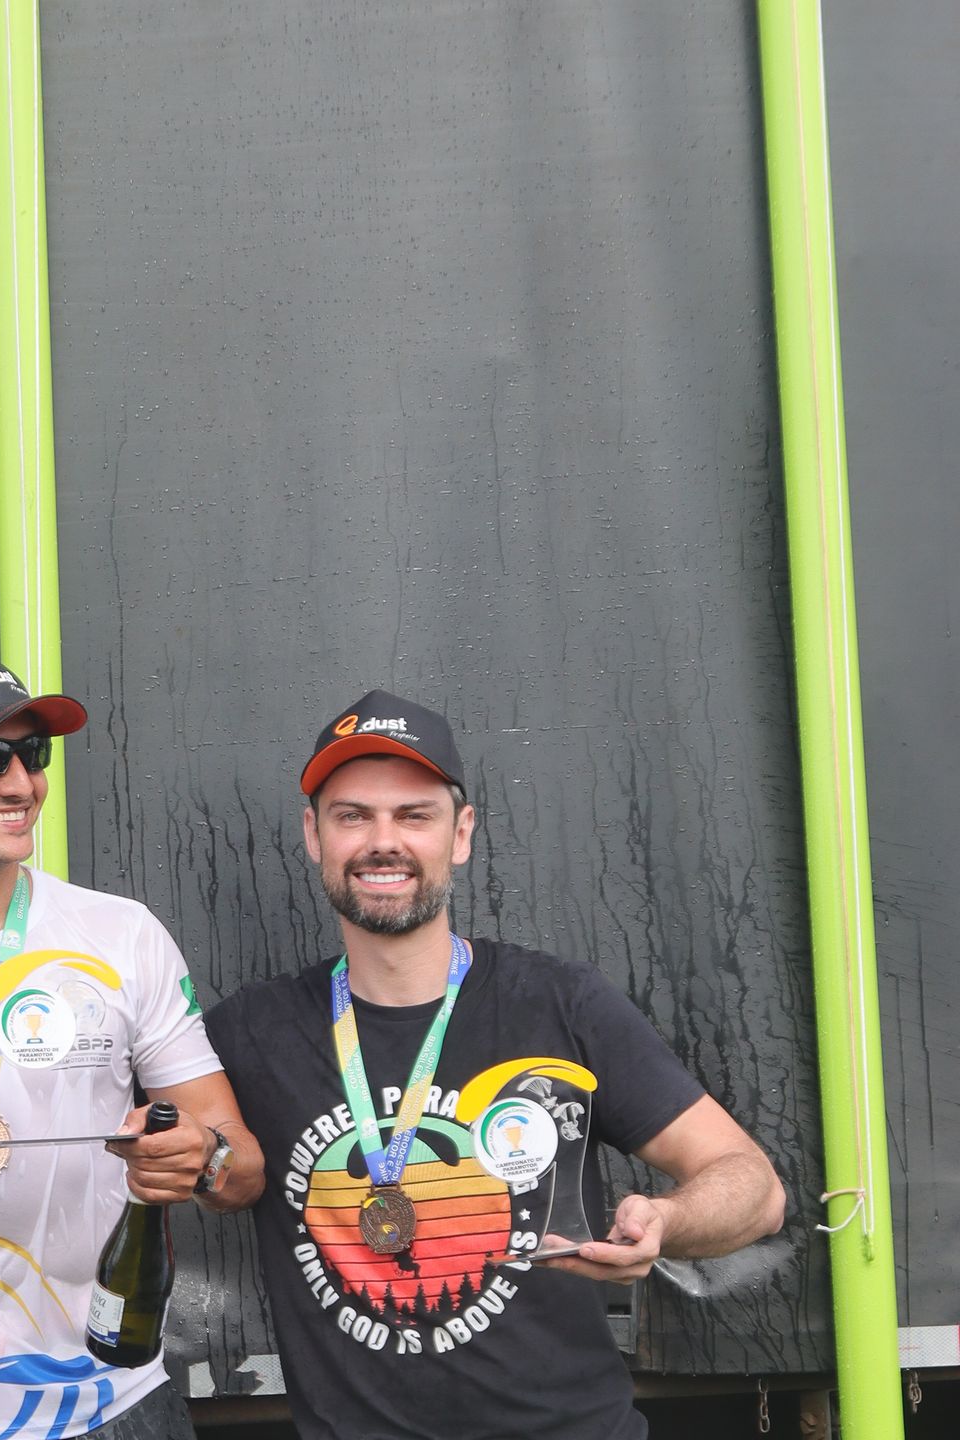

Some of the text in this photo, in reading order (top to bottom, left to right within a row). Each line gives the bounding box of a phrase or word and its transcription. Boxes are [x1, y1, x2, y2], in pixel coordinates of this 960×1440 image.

[356, 717, 408, 733] .dust
[285, 1103, 357, 1211] POWERE
[294, 1242, 340, 1310] ONLY
[338, 1306, 390, 1350] GOD
[396, 1329, 423, 1355] IS
[433, 1275, 518, 1354] ABOVE
